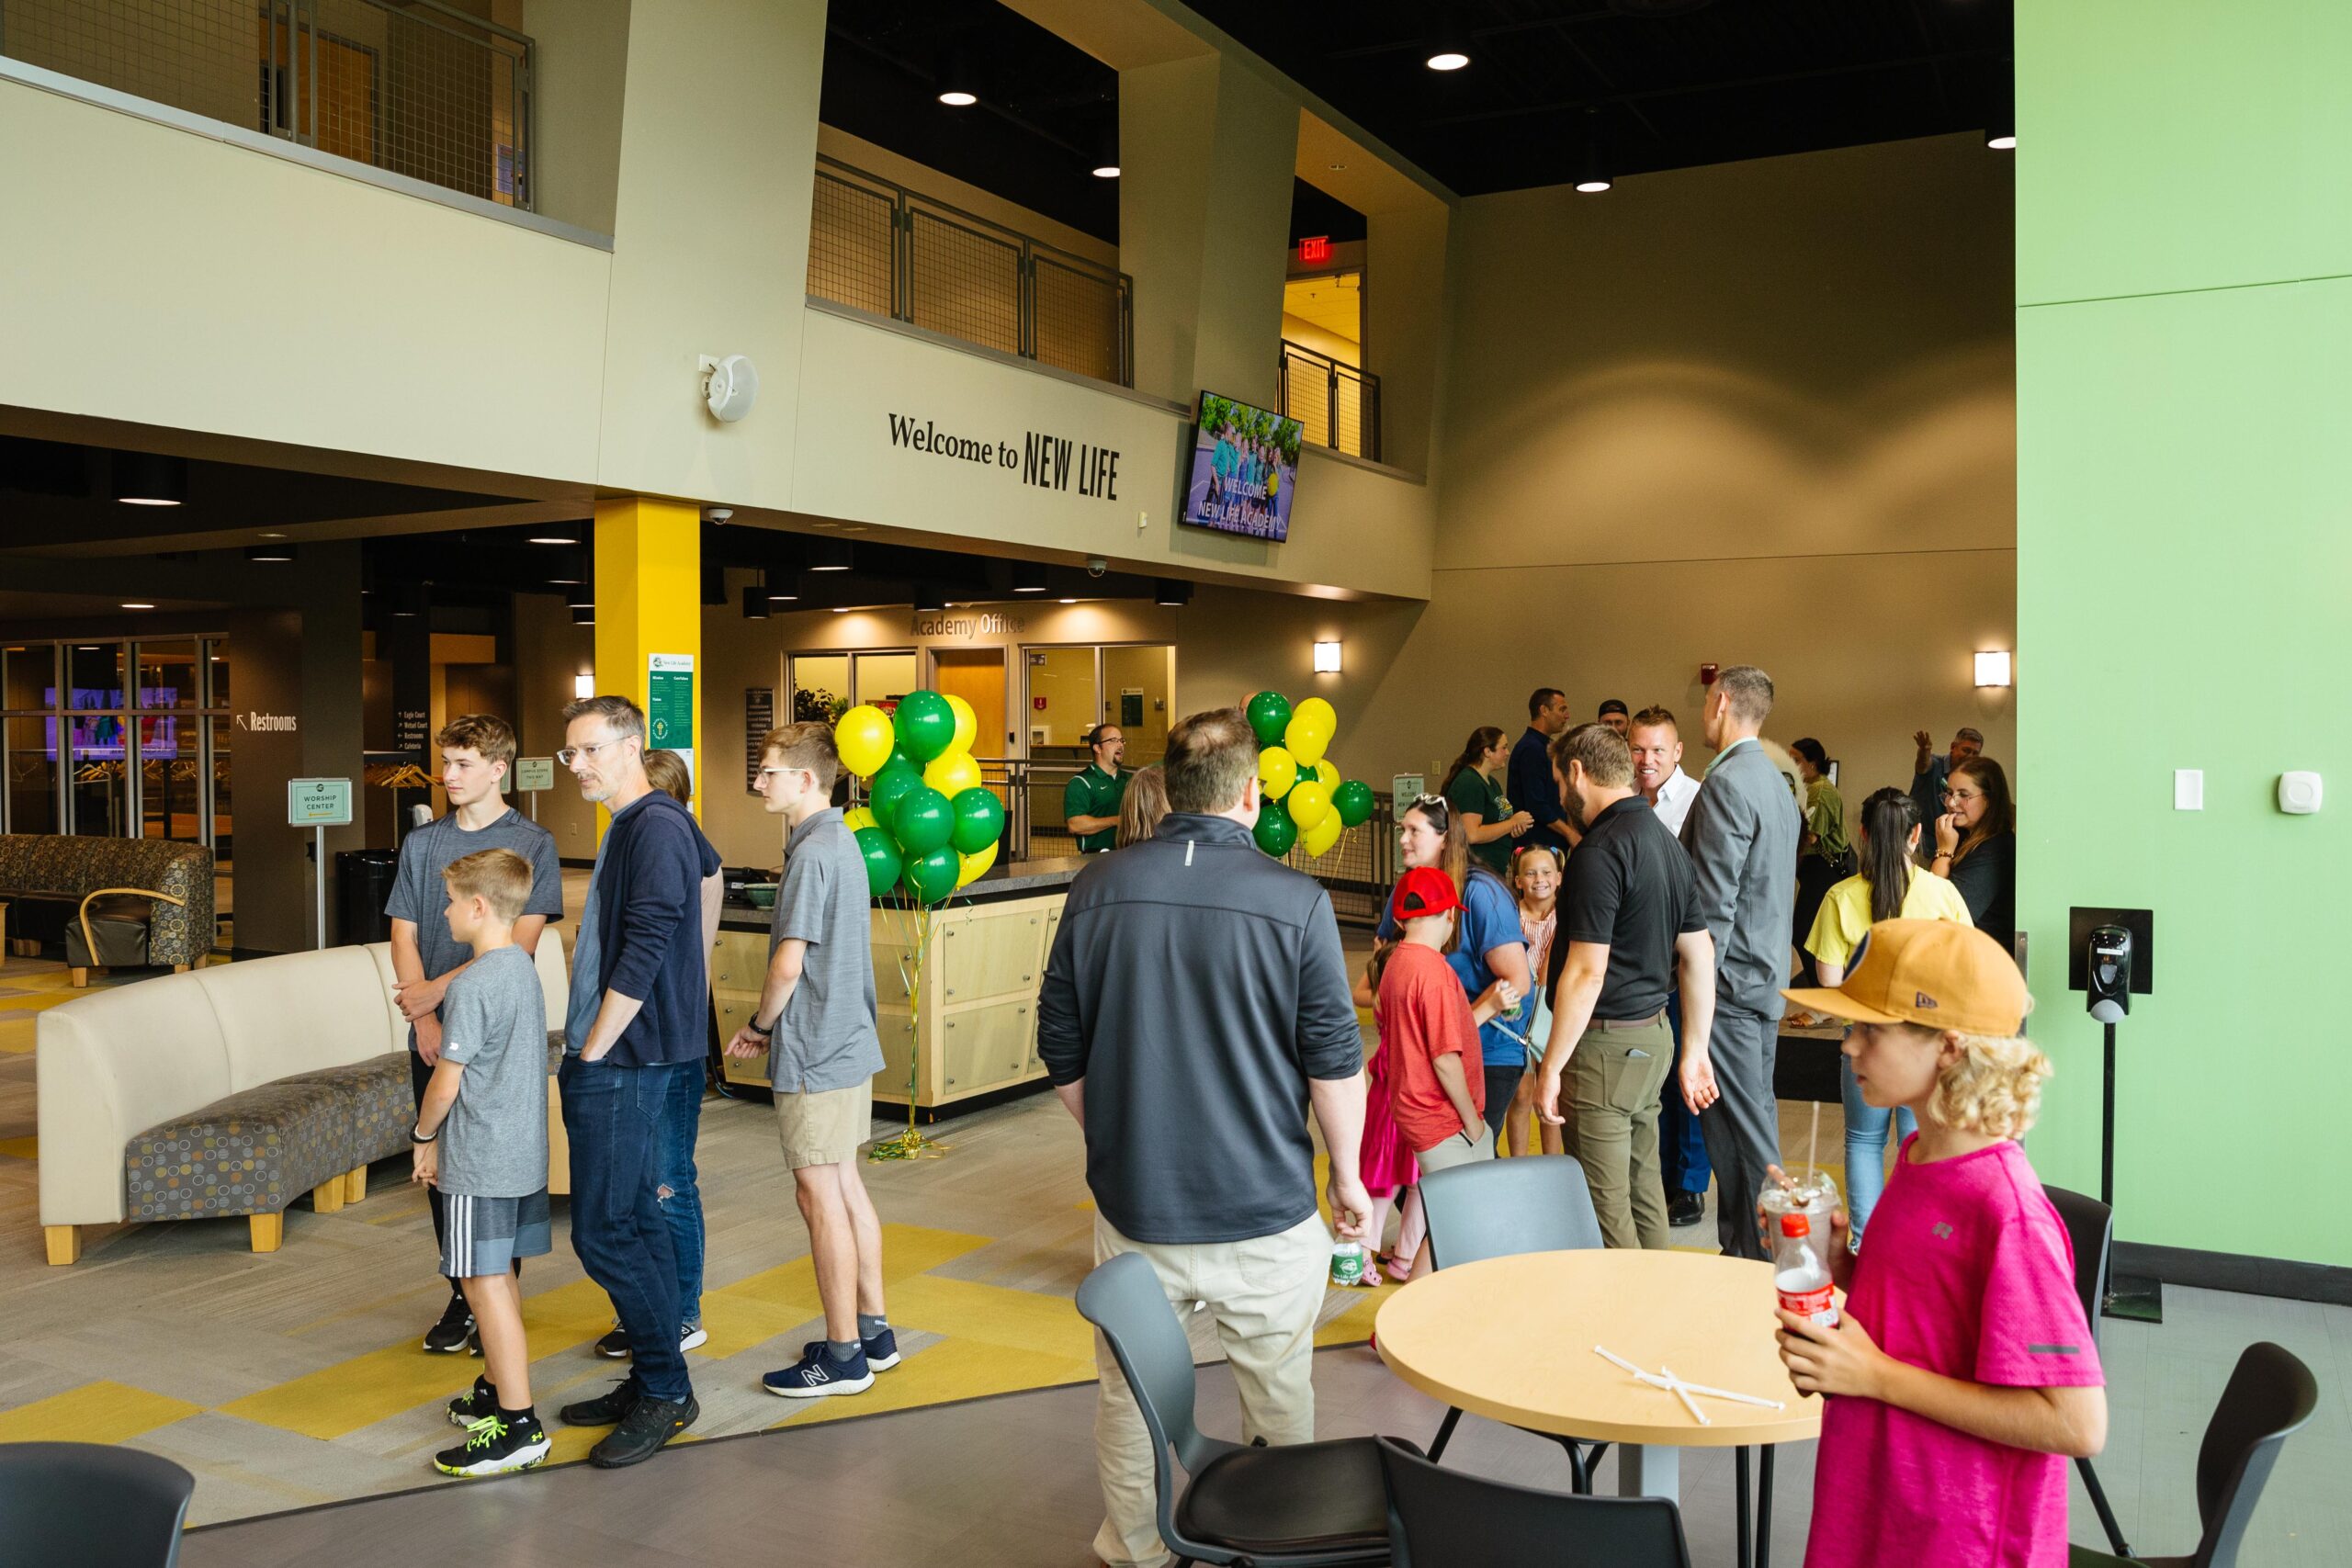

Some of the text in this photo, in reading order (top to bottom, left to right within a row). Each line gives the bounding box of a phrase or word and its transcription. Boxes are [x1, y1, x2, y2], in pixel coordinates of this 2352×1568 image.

[1305, 239, 1326, 259] EXIT
[888, 413, 1120, 502] Welcome to NEW LIFE
[1225, 477, 1268, 500] WELCOME
[1198, 501, 1282, 531] NEW LIFE ACADEMY
[910, 613, 1025, 639] Academy Office
[250, 711, 297, 731] Restrooms
